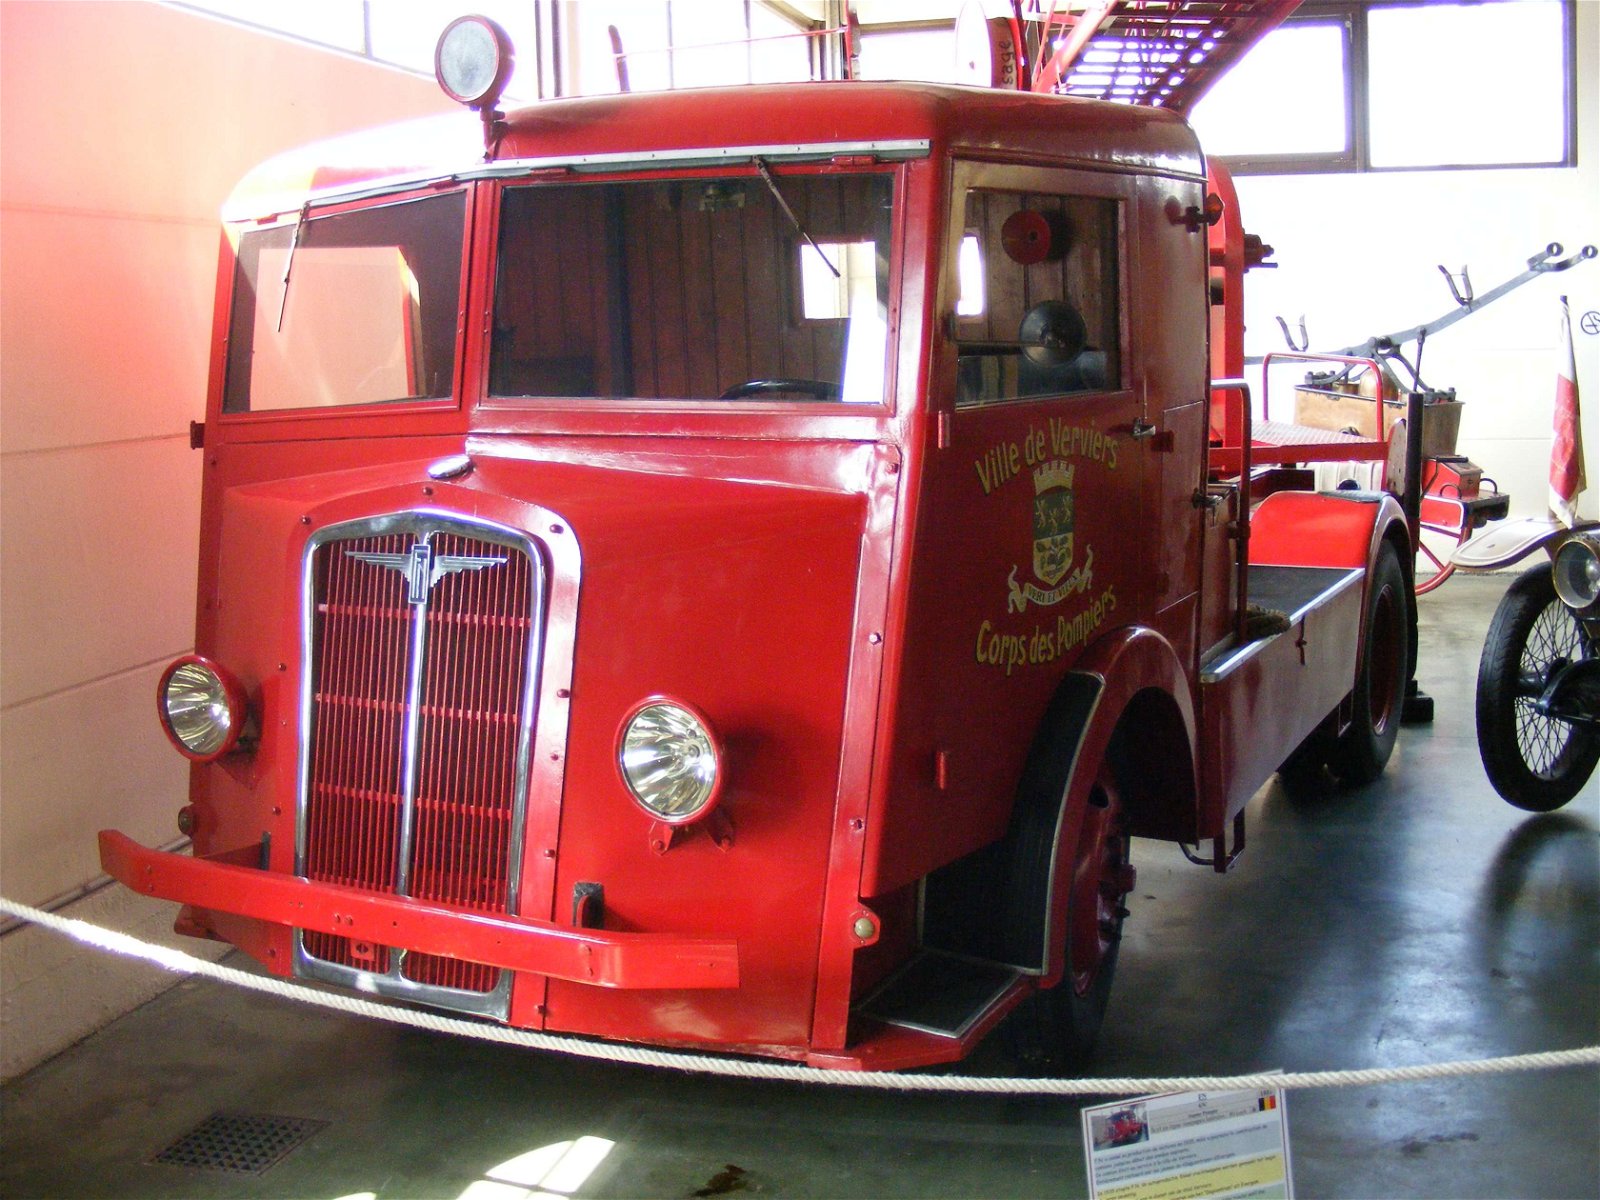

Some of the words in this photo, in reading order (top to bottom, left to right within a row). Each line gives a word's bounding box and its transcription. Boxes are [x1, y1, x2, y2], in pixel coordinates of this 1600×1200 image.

[975, 442, 1021, 495] Ville
[1024, 424, 1046, 466] de
[1049, 417, 1120, 469] Verviers
[976, 619, 1026, 676] Corps
[1029, 625, 1054, 664] des
[1056, 584, 1117, 656] Pompiers
